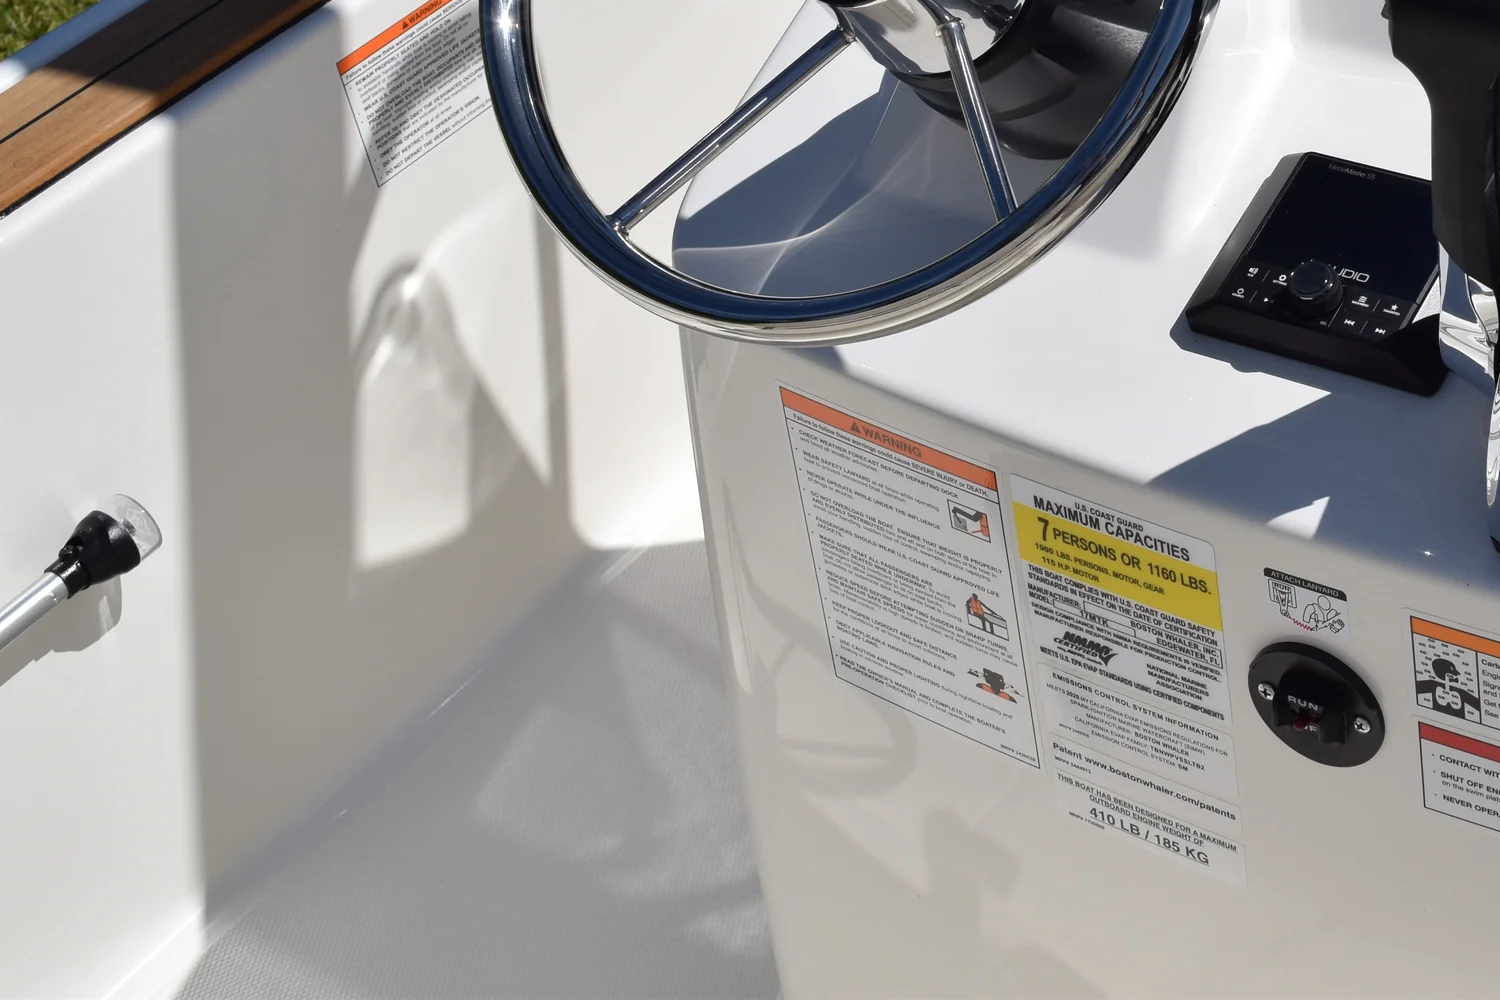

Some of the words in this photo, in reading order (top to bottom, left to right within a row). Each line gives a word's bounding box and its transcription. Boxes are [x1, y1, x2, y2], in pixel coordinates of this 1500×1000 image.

[861, 425, 922, 458] WARNING
[1033, 494, 1100, 531] MAXIMUM
[1104, 521, 1190, 562] CAPACITIES
[1074, 501, 1089, 513] U.S.
[1089, 507, 1115, 522] COAST
[1116, 517, 1144, 532] GUARD
[1034, 542, 1054, 555] 1900
[1055, 549, 1073, 562] LBS.
[1073, 556, 1111, 577] PERSONS,
[1112, 570, 1142, 588] MOTOR,
[1142, 581, 1165, 595] GEAR
[1036, 515, 1049, 542] 7
[1052, 527, 1117, 561] PERSONS
[1120, 552, 1142, 571] OR
[1147, 562, 1177, 583] 1160
[1179, 572, 1211, 595] LBS.
[1041, 555, 1056, 567] 115
[1057, 561, 1071, 572] H.P.
[1072, 566, 1099, 583] MOTOR
[1270, 570, 1301, 586] ATTACH
[1302, 581, 1339, 597] LANYARD
[1027, 582, 1081, 609] MANUFACTURER:
[1130, 620, 1163, 638] BOSTON
[1164, 632, 1202, 652] WHALER,
[1202, 646, 1219, 658] INC.
[1028, 590, 1054, 606] MODEL:
[1079, 610, 1109, 627] 17MTK
[1053, 637, 1099, 658] CERTIFIED
[1156, 637, 1208, 663] EDGEWATER,
[1209, 656, 1220, 666] FL
[1052, 672, 1093, 693] EMISSIONS
[1094, 689, 1131, 708] CONTROL
[1132, 703, 1164, 720] SYSTEM
[1164, 716, 1219, 741] INFORMATION
[1287, 694, 1318, 711] RUN
[1439, 754, 1481, 773] CONTACT
[1052, 741, 1082, 760] Patent
[1084, 756, 1236, 820] www.bostonwhaler.com/patents
[1440, 771, 1464, 784] SHUT
[1466, 779, 1484, 789] OFF
[1442, 794, 1472, 809] NEVER
[1089, 807, 1115, 826] 410
[1120, 818, 1140, 836] LB
[1144, 829, 1150, 840] /
[1154, 834, 1180, 853] 185
[1185, 845, 1209, 865] KG
